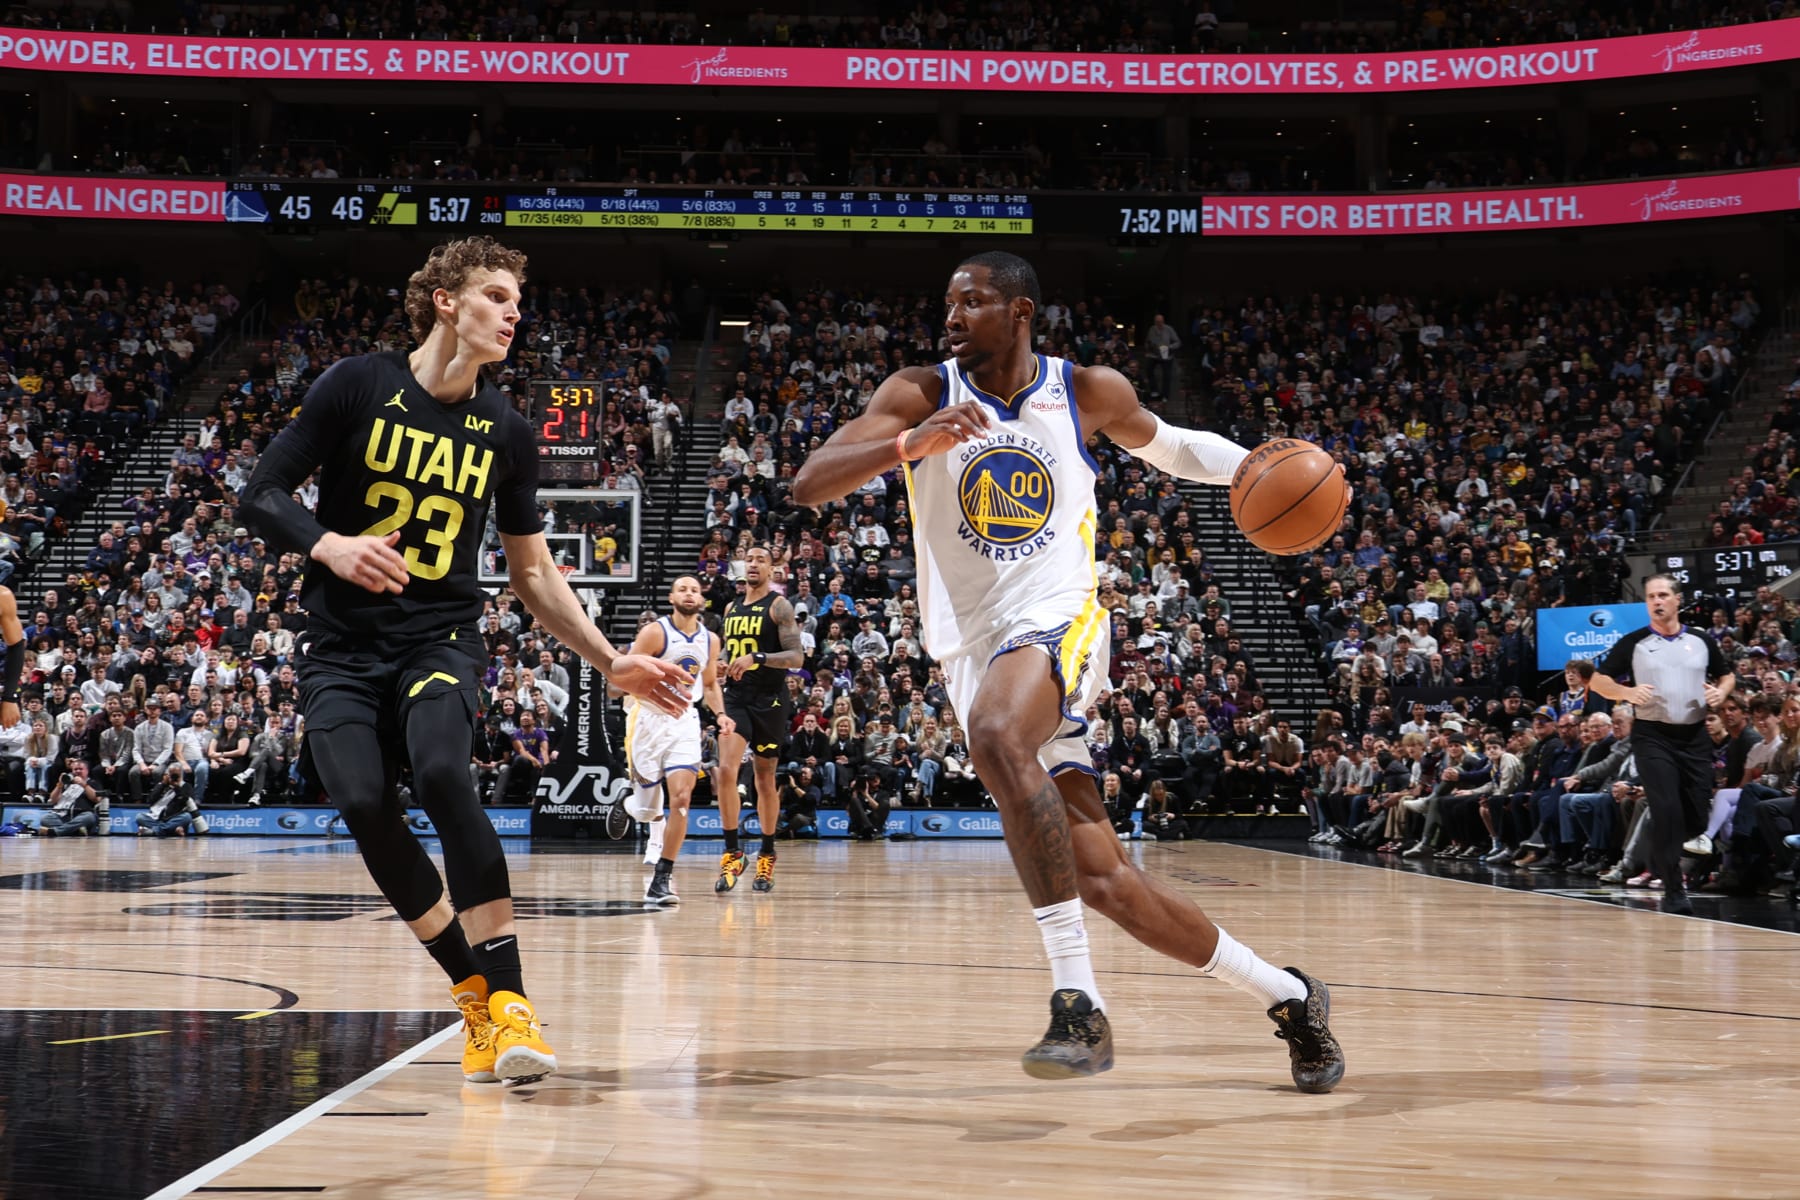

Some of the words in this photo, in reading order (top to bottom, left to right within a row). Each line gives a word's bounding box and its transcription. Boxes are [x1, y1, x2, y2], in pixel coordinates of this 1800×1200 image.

[0, 35, 136, 70] POWDER,
[147, 43, 374, 75] ELECTROLYTES,
[385, 48, 404, 72] &
[416, 49, 629, 76] PRE-WORKOUT
[1677, 44, 1763, 62] INGREDIENTS
[705, 66, 788, 79] INGREDIENTS
[847, 56, 971, 83] PROTEIN
[983, 59, 1113, 88] POWDER,
[1123, 61, 1344, 88] ELECTROLYTES,
[1353, 61, 1373, 85] &
[1384, 48, 1599, 84] PRE-WORKOUT
[6, 183, 83, 211] REAL
[484, 197, 500, 209] 21
[547, 188, 557, 196] FG
[704, 190, 715, 198] FT
[840, 192, 854, 200] AST
[867, 193, 882, 201] STL
[895, 193, 910, 201] BLK
[923, 194, 938, 202] TOV
[948, 194, 973, 202] BENCH
[1655, 195, 1742, 212] INGREDIENTS
[280, 196, 311, 220] 45
[331, 196, 363, 220] 46
[429, 198, 471, 222] 5:37
[519, 198, 552, 209] 16/36
[553, 198, 585, 210] (44%)
[600, 199, 626, 210] 8/18
[628, 199, 660, 211] (44%)
[682, 200, 703, 211] 5/6
[704, 200, 736, 213] (83%)
[758, 201, 767, 212] 3
[784, 202, 797, 213] 12
[812, 202, 825, 213] 15
[842, 203, 852, 214] 11
[871, 203, 878, 214] 1
[898, 203, 907, 215] 0
[926, 204, 935, 215] 5
[954, 205, 966, 215] 13
[981, 205, 995, 216] 111
[1007, 206, 1024, 216] 114
[1280, 204, 1338, 229] FOR
[1348, 202, 1453, 229] BETTER
[1463, 196, 1584, 225] HEALTH.
[481, 212, 502, 223] 2ND
[519, 213, 550, 224] 17/35
[551, 213, 583, 226] (49%)
[601, 214, 626, 225] 5/13
[627, 214, 660, 226] (38%)
[682, 215, 702, 227] 7/8
[704, 216, 736, 228] (88%)
[758, 217, 767, 228] 5
[784, 217, 797, 228] 14
[812, 217, 825, 228] 19
[842, 218, 852, 229] 11
[870, 218, 879, 229] 2
[898, 219, 907, 229] 4
[926, 219, 934, 230] 7
[953, 220, 967, 230] 24
[980, 220, 996, 231] 114
[1008, 221, 1023, 231] 111
[1120, 208, 1161, 234] 7:52
[1167, 208, 1197, 234] PM
[551, 387, 594, 407] 5:37
[1031, 401, 1067, 411] Rakuten
[464, 414, 495, 434] LVT
[543, 408, 588, 440] 21
[364, 417, 494, 500] UTAH
[549, 446, 597, 456] TISSOT
[960, 434, 1015, 463] GOLDEN
[1021, 437, 1057, 468] STATE
[1010, 471, 1043, 499] 00
[359, 481, 465, 581] 23
[956, 520, 1056, 562] WARRIORS
[1715, 551, 1753, 571] 5:37
[1671, 570, 1689, 584] 45
[724, 615, 763, 637] UTAH
[1564, 630, 1623, 649] Gallagh
[579, 656, 593, 691] FIRS
[577, 693, 592, 757] AMERICA
[539, 804, 590, 814] AMERICA
[592, 804, 614, 814] FIR
[204, 812, 262, 829] llagher
[958, 817, 1002, 831] Galla
